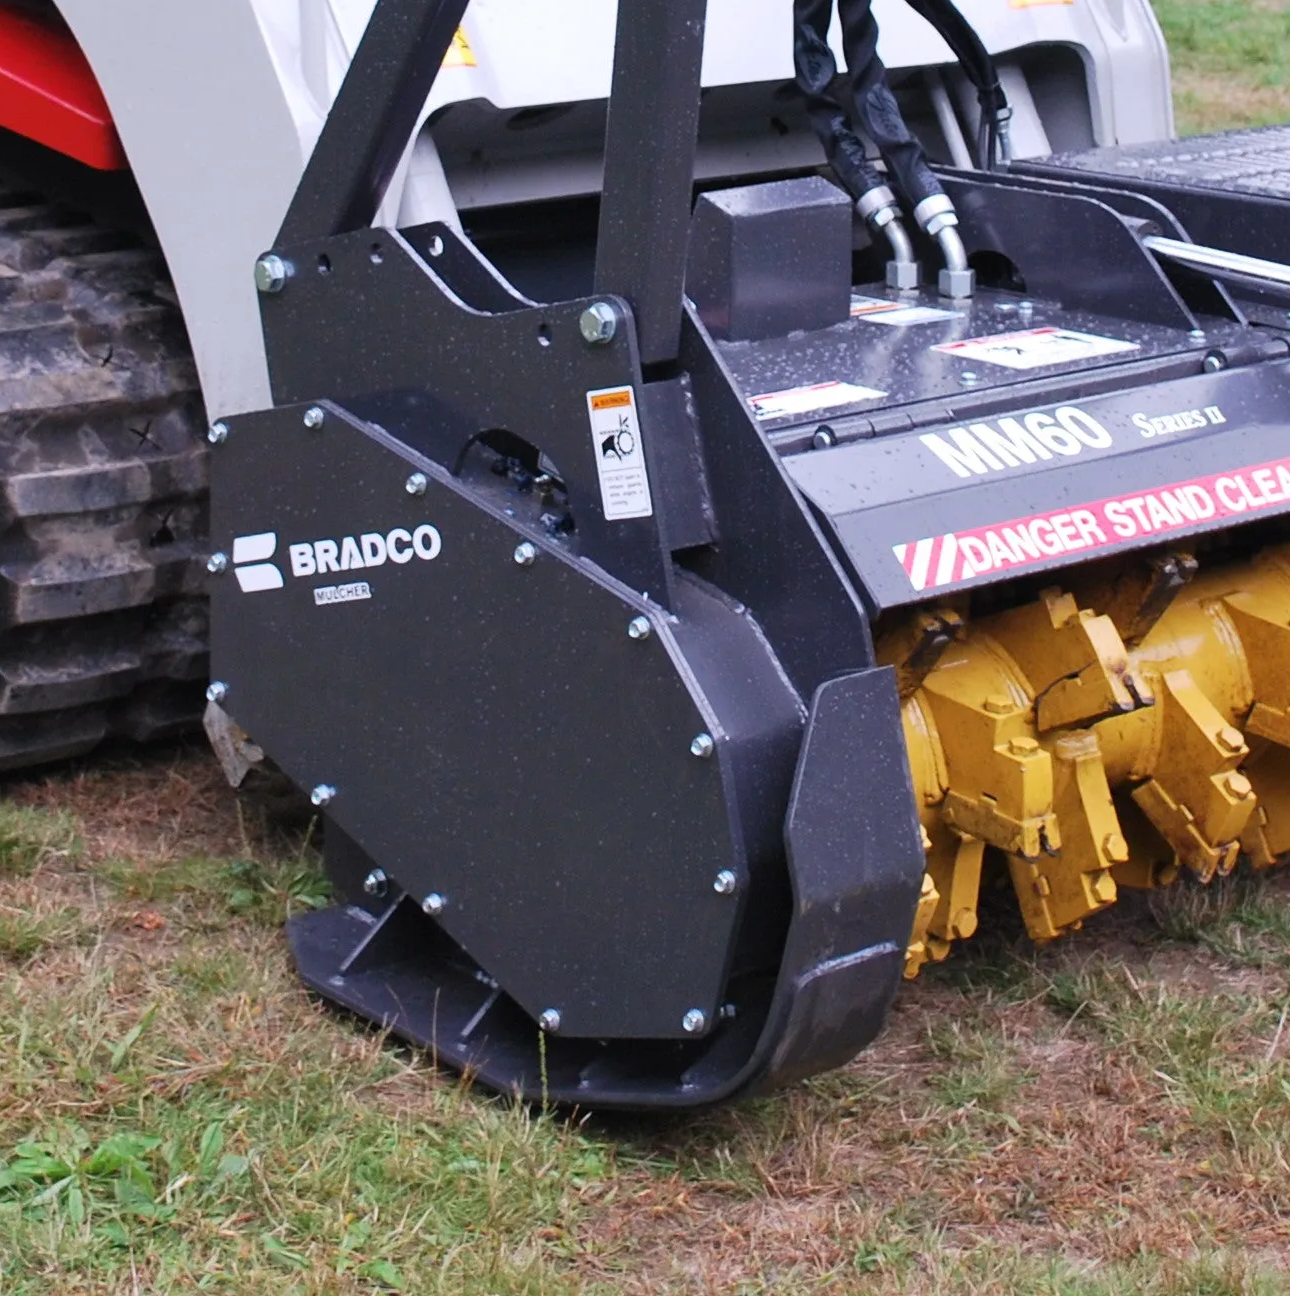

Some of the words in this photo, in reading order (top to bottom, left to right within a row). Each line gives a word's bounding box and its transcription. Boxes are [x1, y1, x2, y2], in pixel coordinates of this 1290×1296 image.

[920, 407, 1114, 478] MM60
[289, 524, 442, 577] BRADCO
[955, 510, 1106, 573] DANGER
[1109, 484, 1215, 539] STAND
[316, 584, 370, 602] MULCHER
